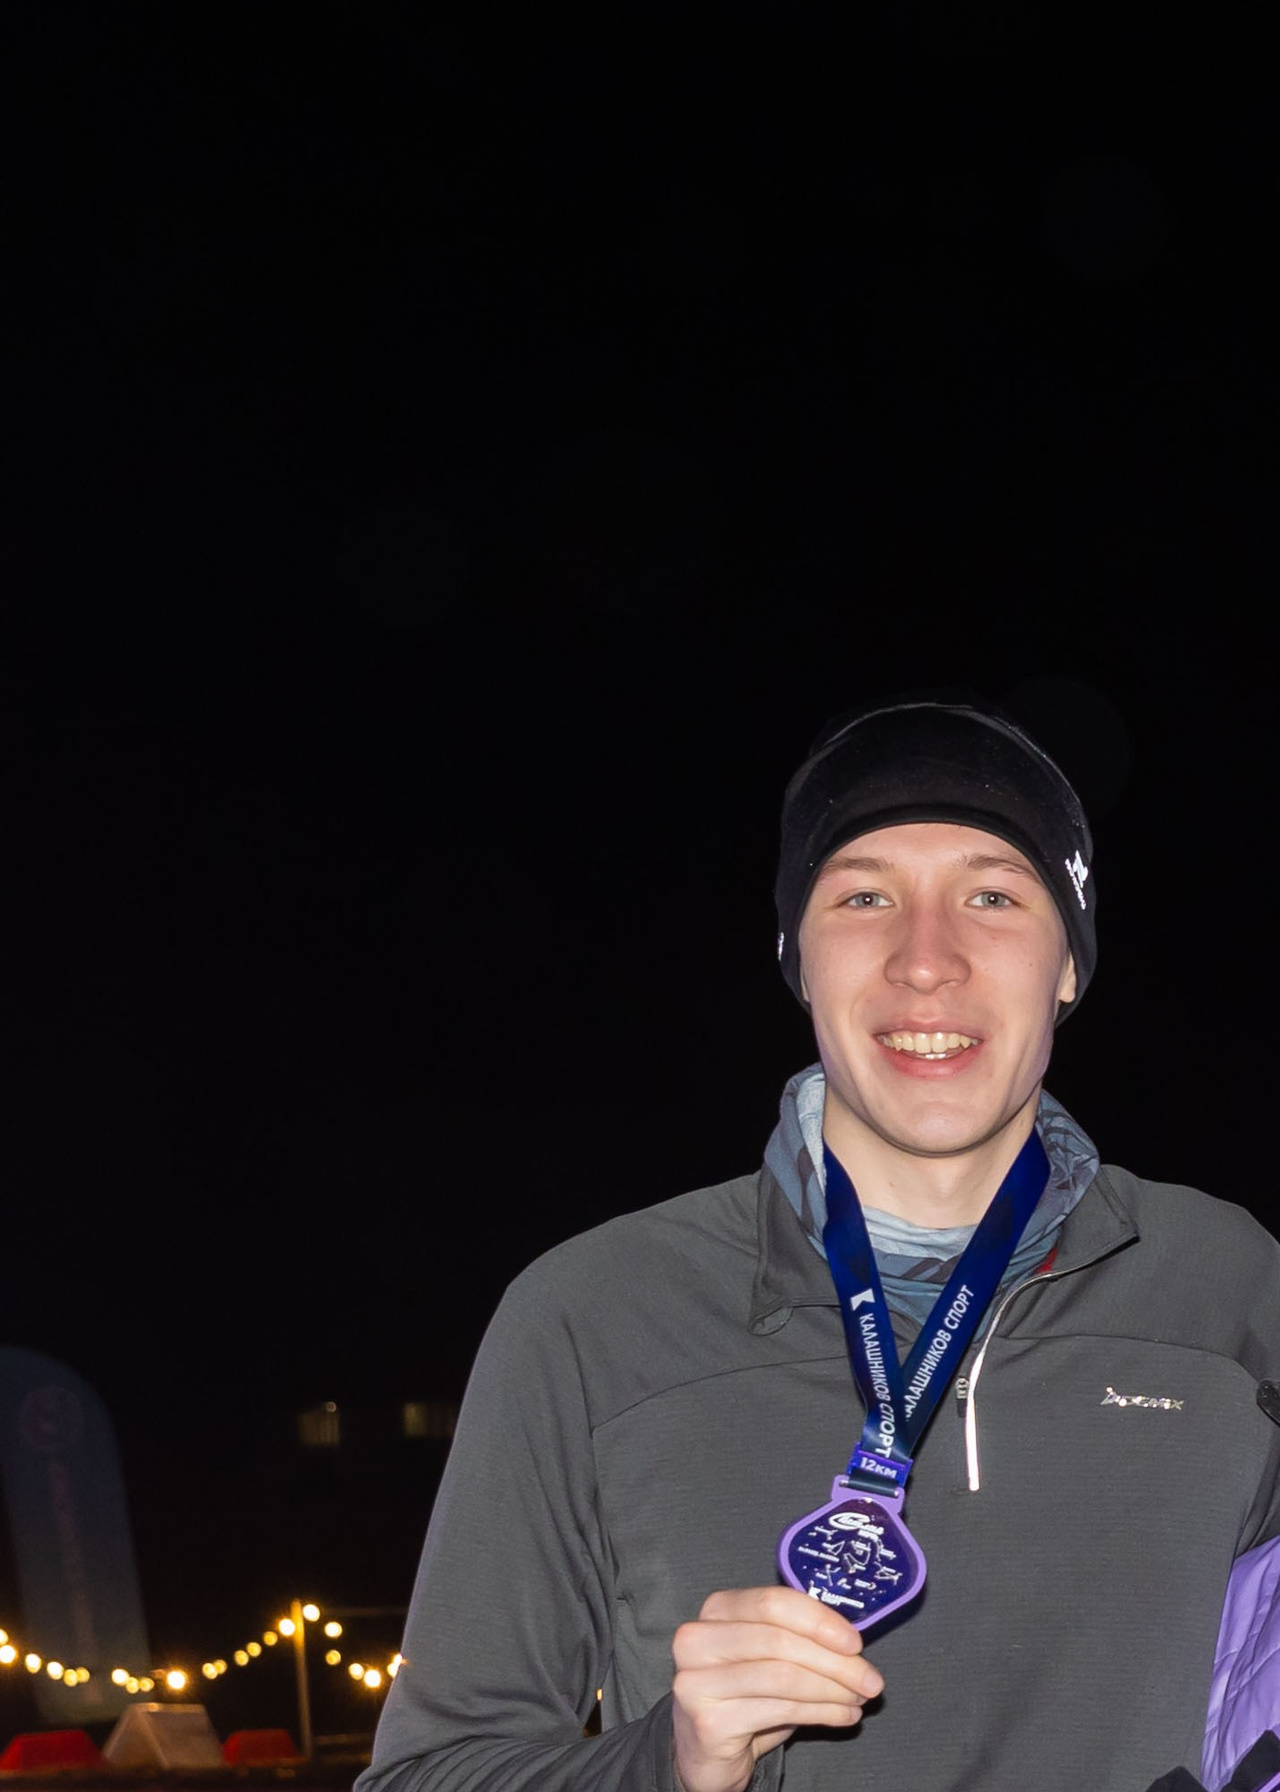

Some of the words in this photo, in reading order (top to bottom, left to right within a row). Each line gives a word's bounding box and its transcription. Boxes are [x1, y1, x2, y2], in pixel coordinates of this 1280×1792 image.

[859, 1313, 891, 1402] КАЛАШНИКОВ
[875, 1403, 895, 1458] СПОРТ
[904, 1329, 951, 1420] АЛАШНИКОВ
[944, 1285, 975, 1329] СПОРТ
